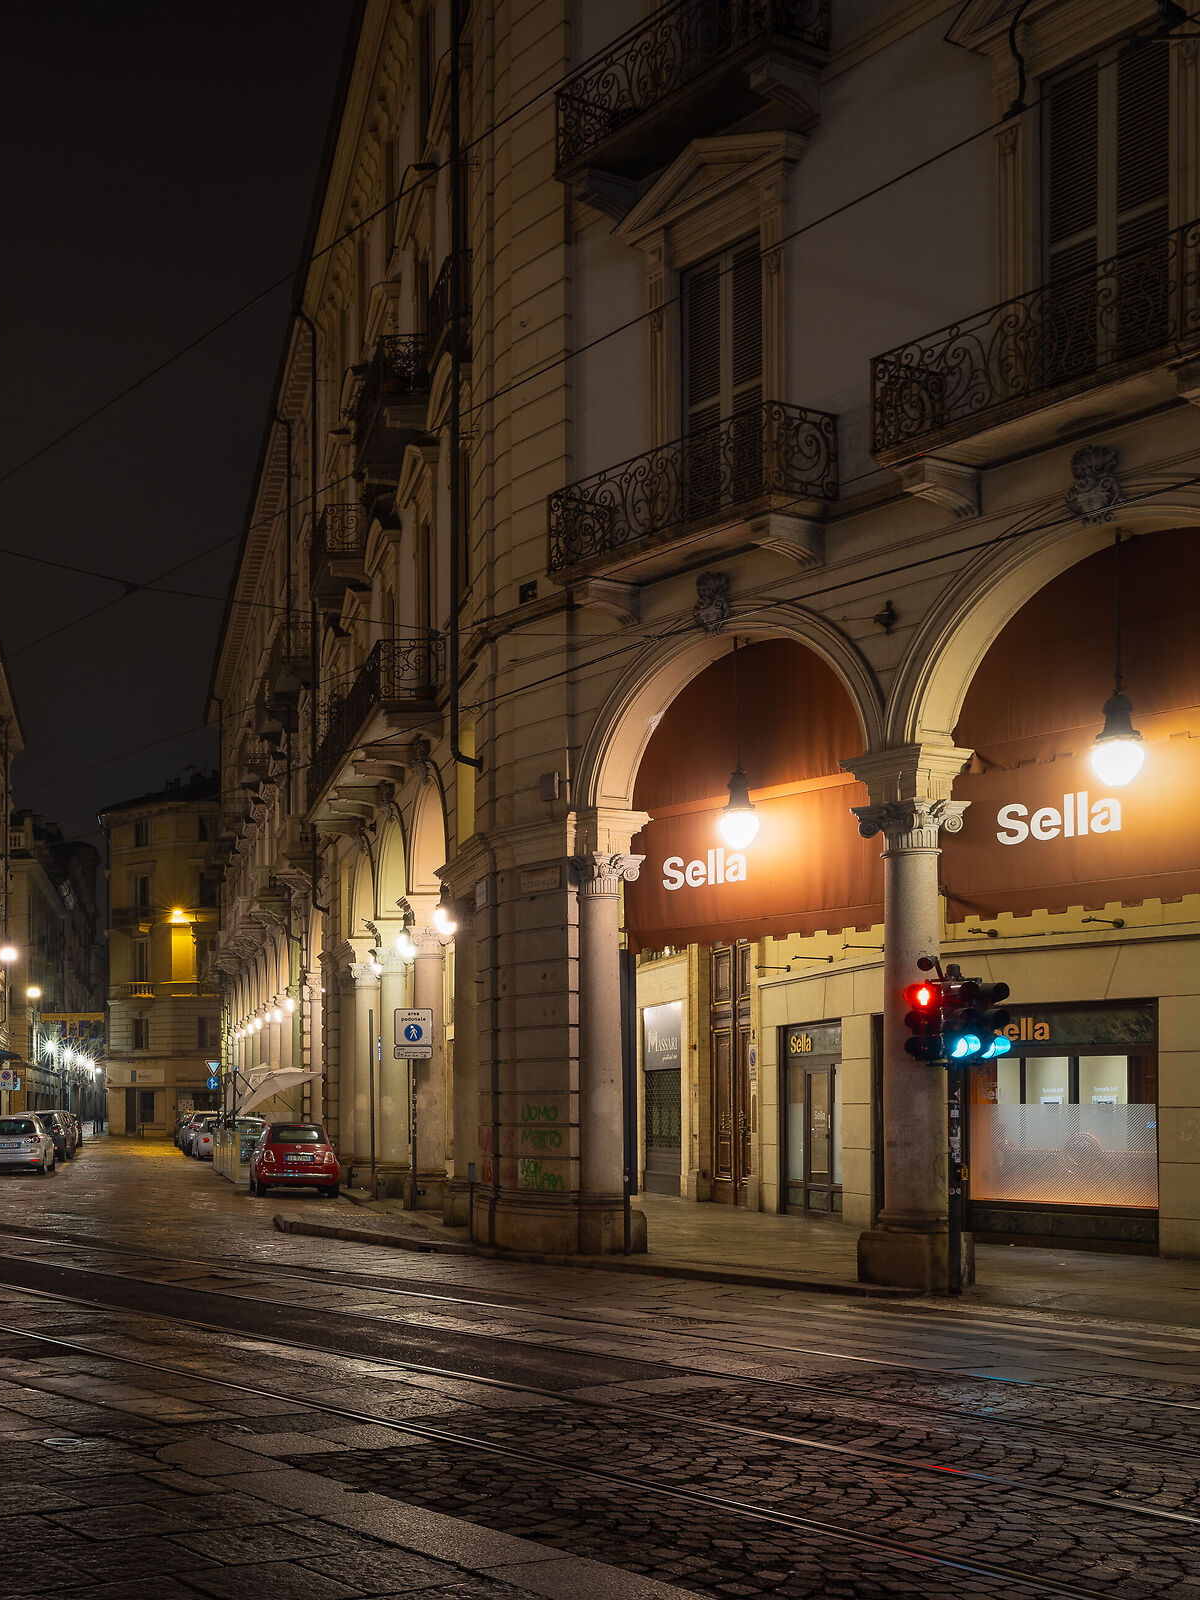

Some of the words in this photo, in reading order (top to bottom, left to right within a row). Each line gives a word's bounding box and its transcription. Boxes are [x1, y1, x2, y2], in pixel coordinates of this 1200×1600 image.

[996, 791, 1122, 846] Sella
[662, 848, 747, 891] Sella
[994, 1017, 1050, 1041] ella
[790, 1033, 811, 1054] Sella
[521, 1104, 558, 1121] UOMO
[520, 1159, 544, 1176] NON
